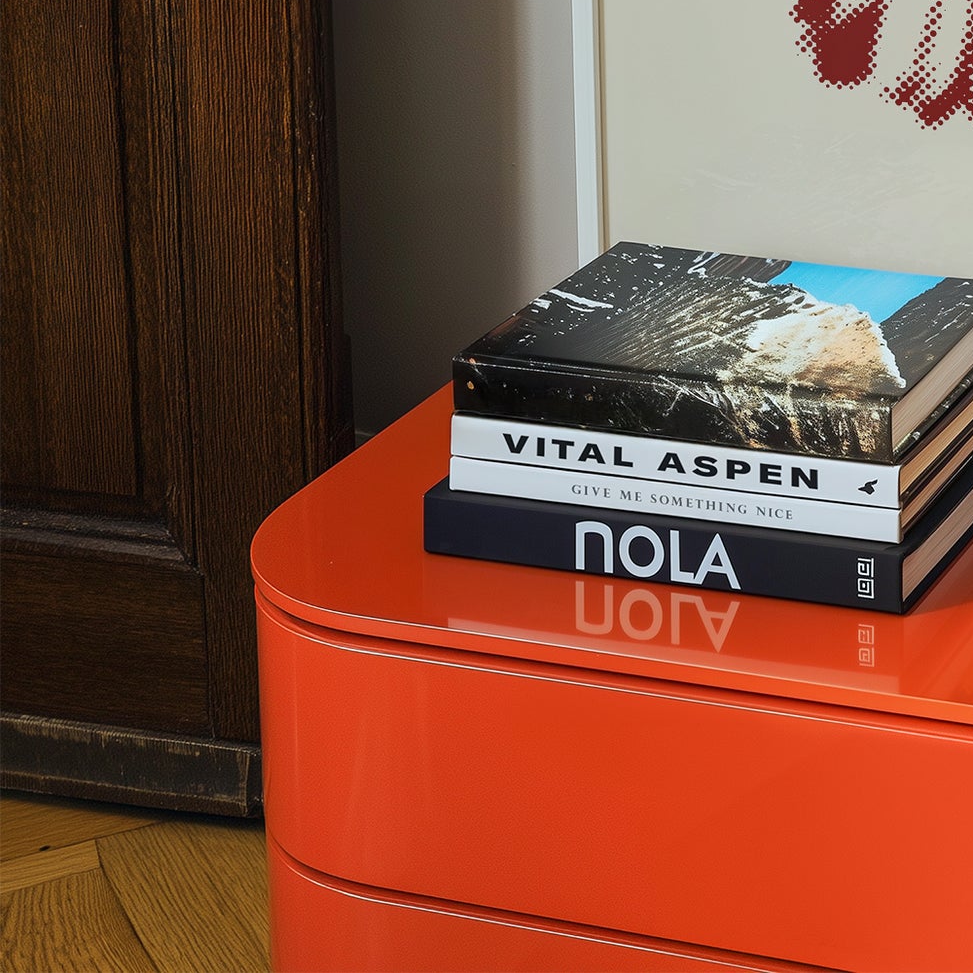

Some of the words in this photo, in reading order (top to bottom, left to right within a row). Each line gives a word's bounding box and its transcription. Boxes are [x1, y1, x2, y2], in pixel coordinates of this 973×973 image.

[502, 432, 634, 468] VITAL
[656, 451, 820, 490] ASPEN
[571, 484, 611, 499] GIVE
[619, 489, 642, 503] ME
[650, 493, 748, 515] SOMETHING
[755, 505, 794, 520] NICE
